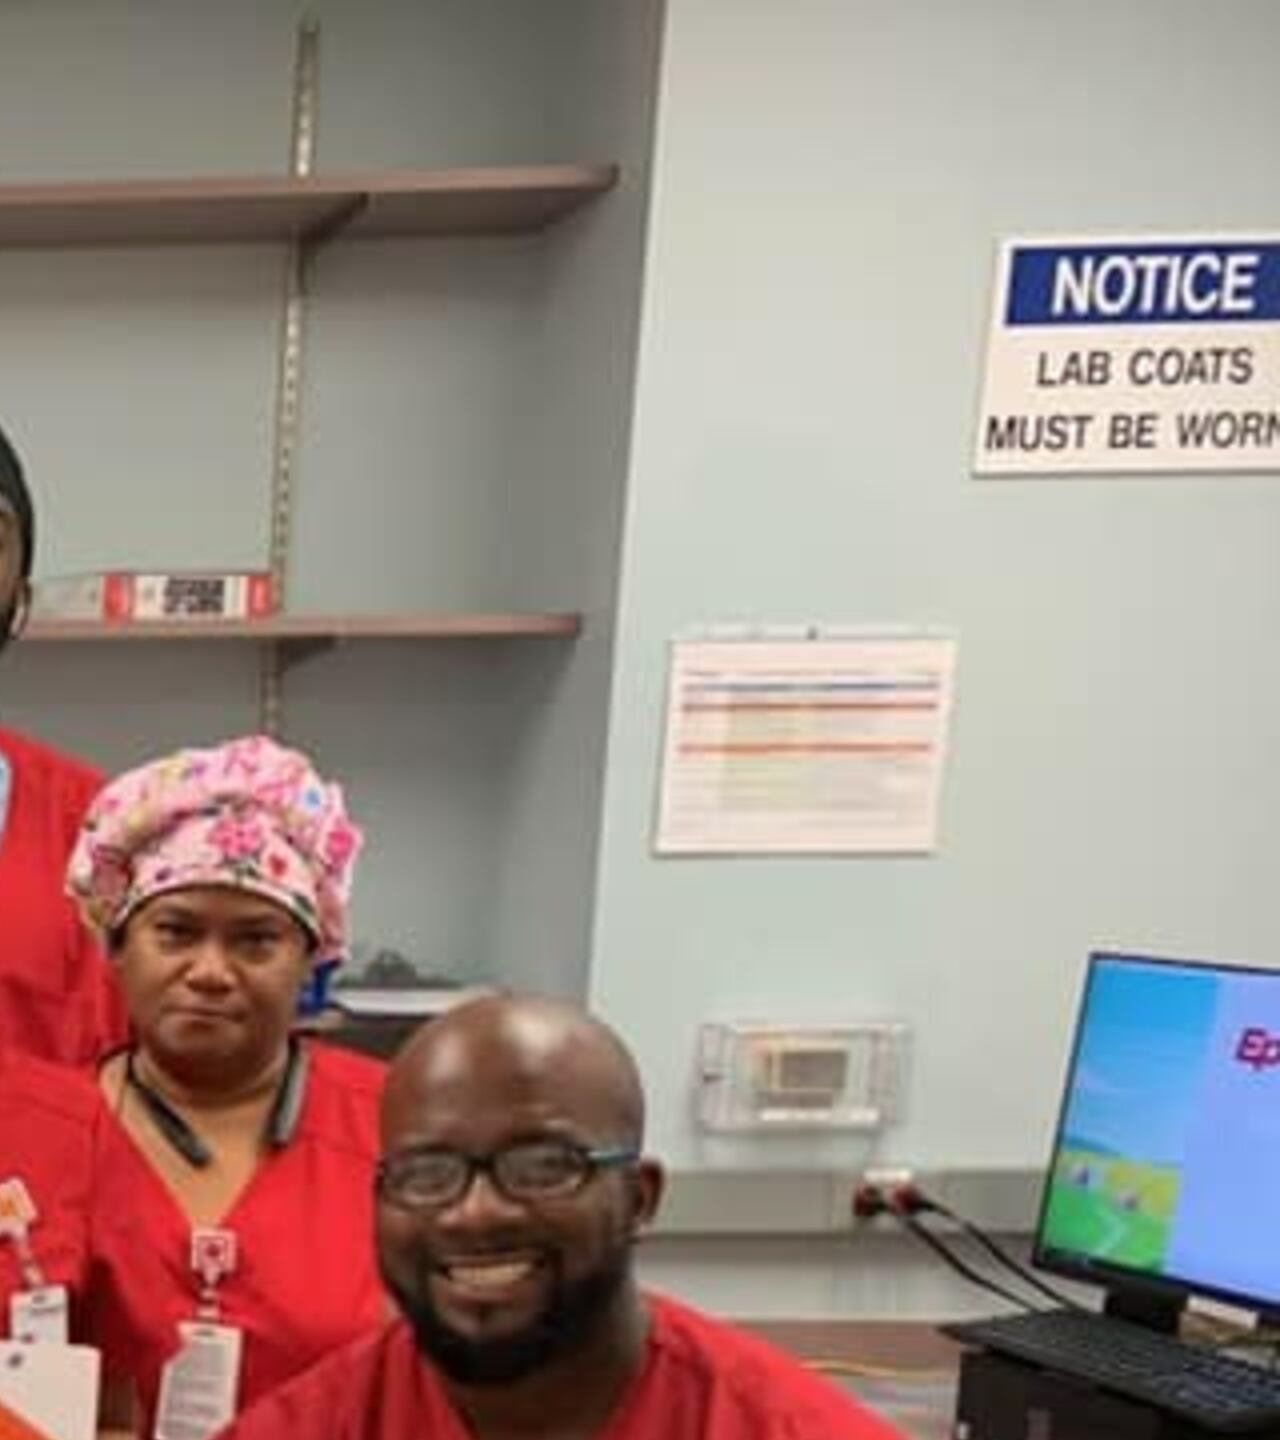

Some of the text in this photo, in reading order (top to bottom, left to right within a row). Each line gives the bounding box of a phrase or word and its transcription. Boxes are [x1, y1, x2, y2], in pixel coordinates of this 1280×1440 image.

[1051, 253, 1260, 316] NOTICE
[1036, 347, 1254, 387] LAB COATS
[985, 414, 1093, 451] MUST
[1108, 413, 1158, 450] BE
